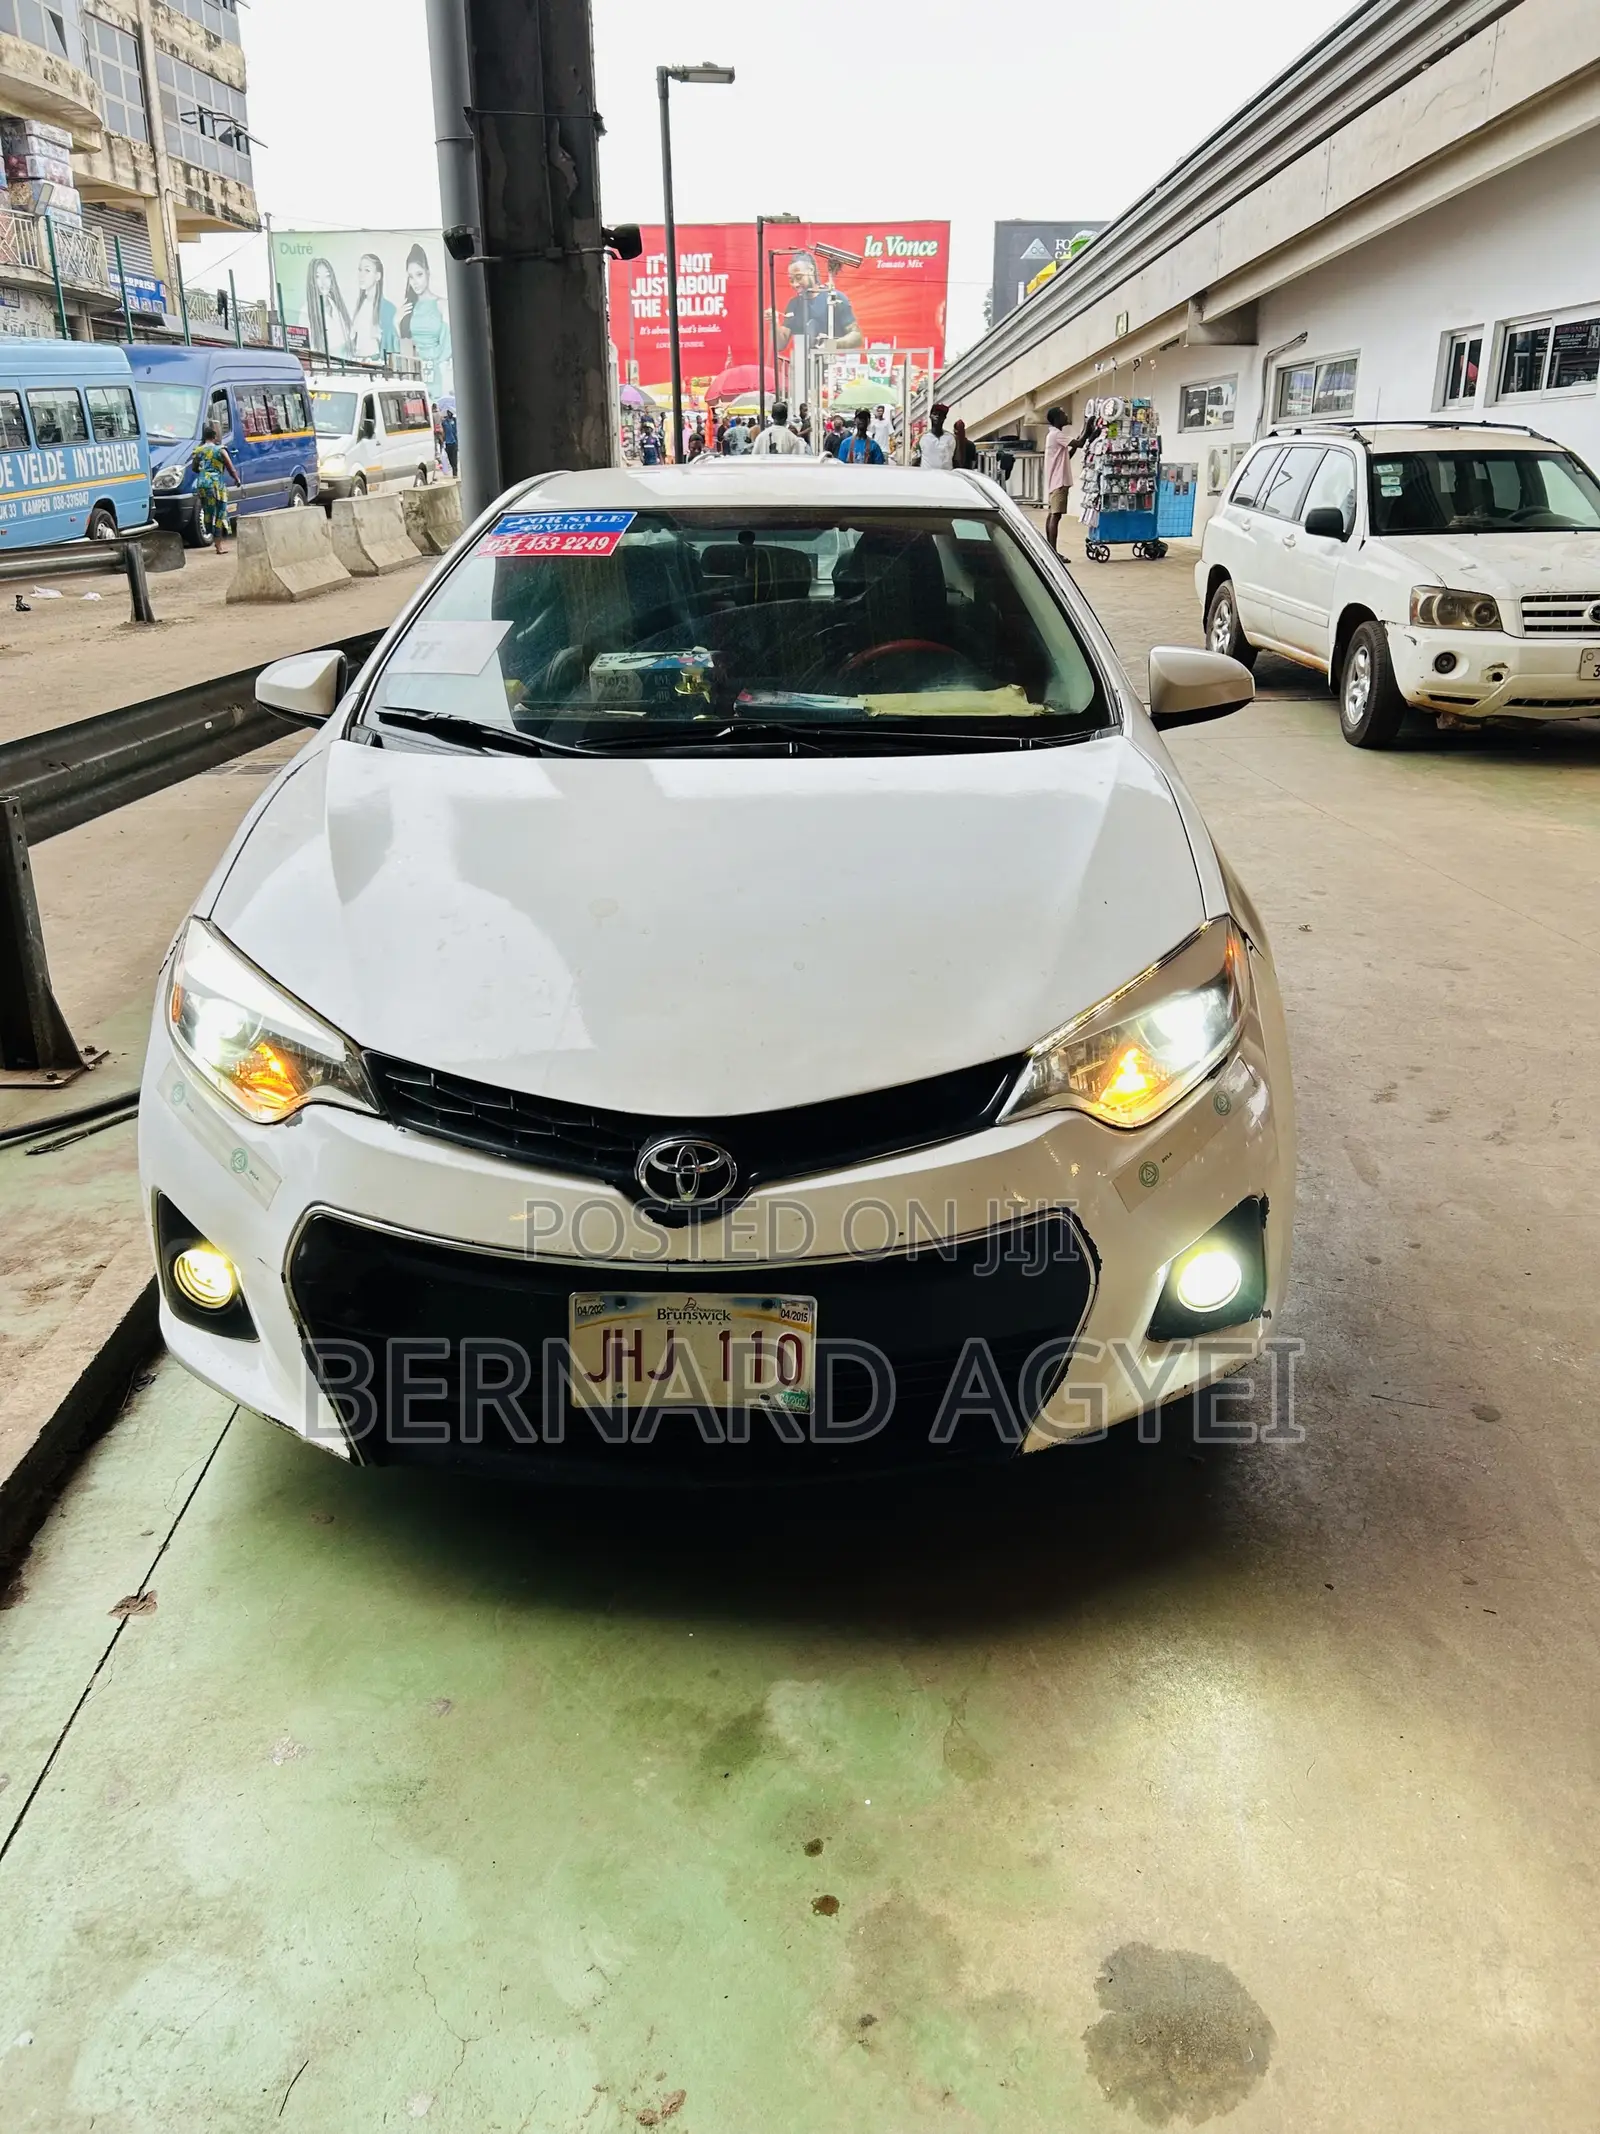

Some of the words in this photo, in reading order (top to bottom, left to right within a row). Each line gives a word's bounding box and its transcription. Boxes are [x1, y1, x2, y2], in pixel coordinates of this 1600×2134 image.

[280, 241, 313, 255] Outré
[864, 234, 884, 257] la
[885, 234, 938, 257] Vonce
[680, 253, 713, 274] NOT
[877, 260, 905, 269] Tomato
[907, 259, 924, 268] Mix
[110, 272, 156, 292] ENERPRISE
[630, 276, 669, 297] JUST
[676, 274, 729, 296] ABOUT
[631, 298, 662, 318] THE
[678, 325, 697, 334] hat's
[16, 450, 67, 485] VELDE
[72, 442, 141, 478] INTERIEUR
[21, 495, 51, 517] KAMPEN
[566, 515, 626, 523] SALE
[657, 1308, 732, 1321] Brunswick
[780, 1309, 808, 1323] 04/2015
[583, 1328, 676, 1383] JHJ
[718, 1329, 803, 1387] 110
